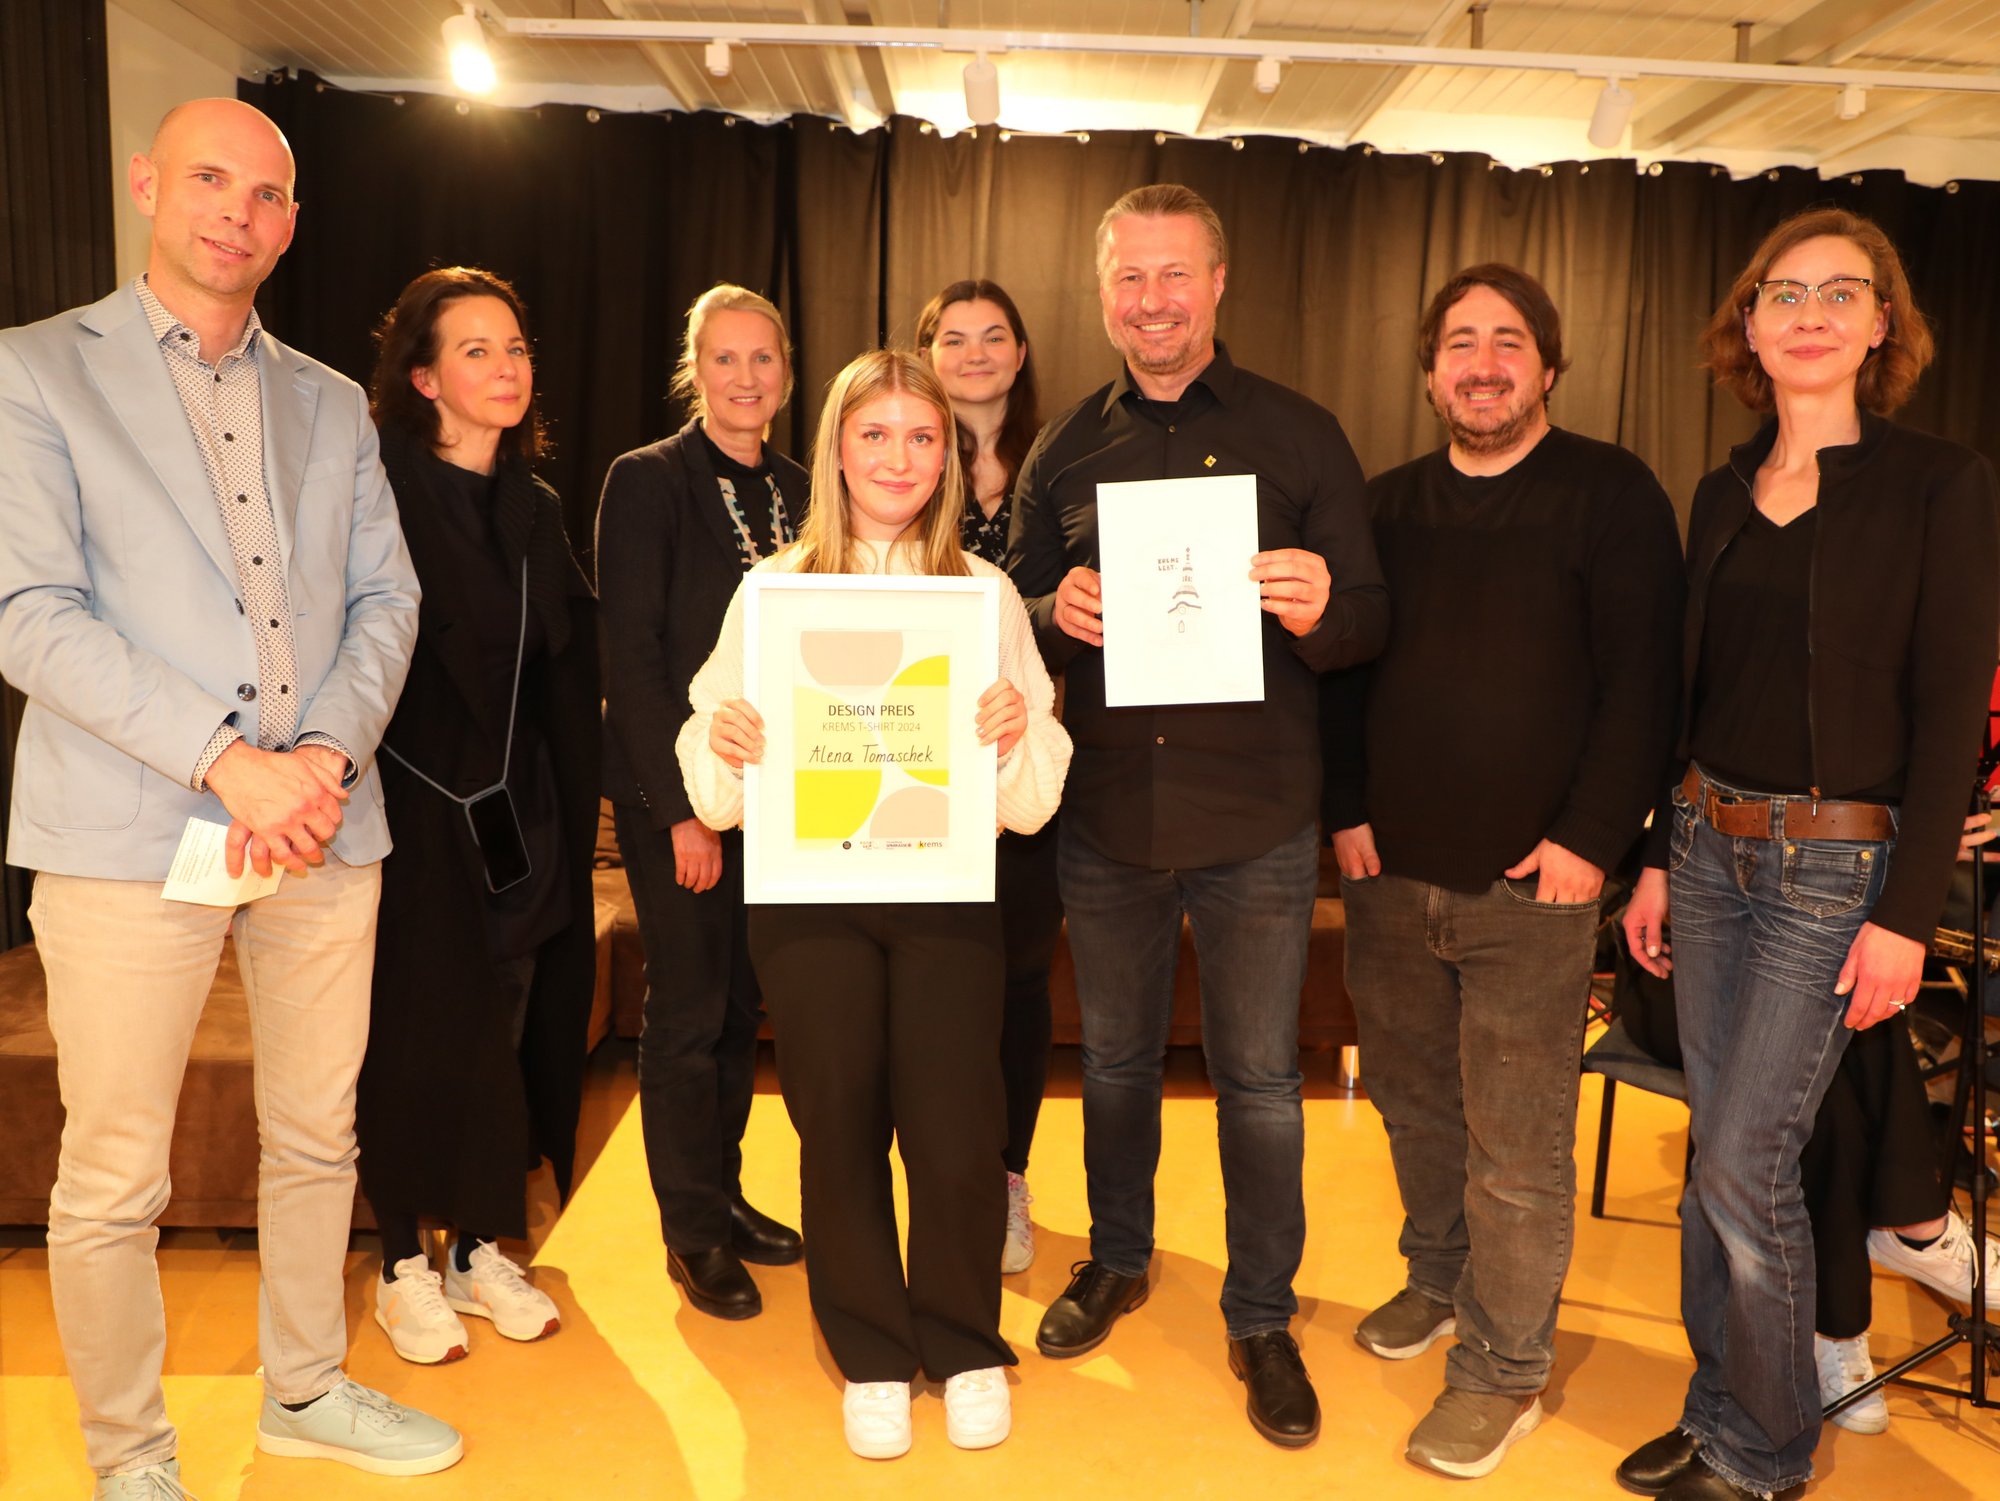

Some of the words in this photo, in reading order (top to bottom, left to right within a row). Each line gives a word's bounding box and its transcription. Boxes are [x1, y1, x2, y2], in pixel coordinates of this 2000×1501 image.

[828, 705, 875, 716] DESIGN
[880, 705, 915, 716] PREIS
[822, 722, 855, 732] KREMS
[858, 722, 895, 732] T-SHIRT
[897, 722, 921, 732] 2024
[808, 744, 854, 763] Alena
[862, 743, 934, 763] Tomaschek
[919, 840, 943, 848] krems
